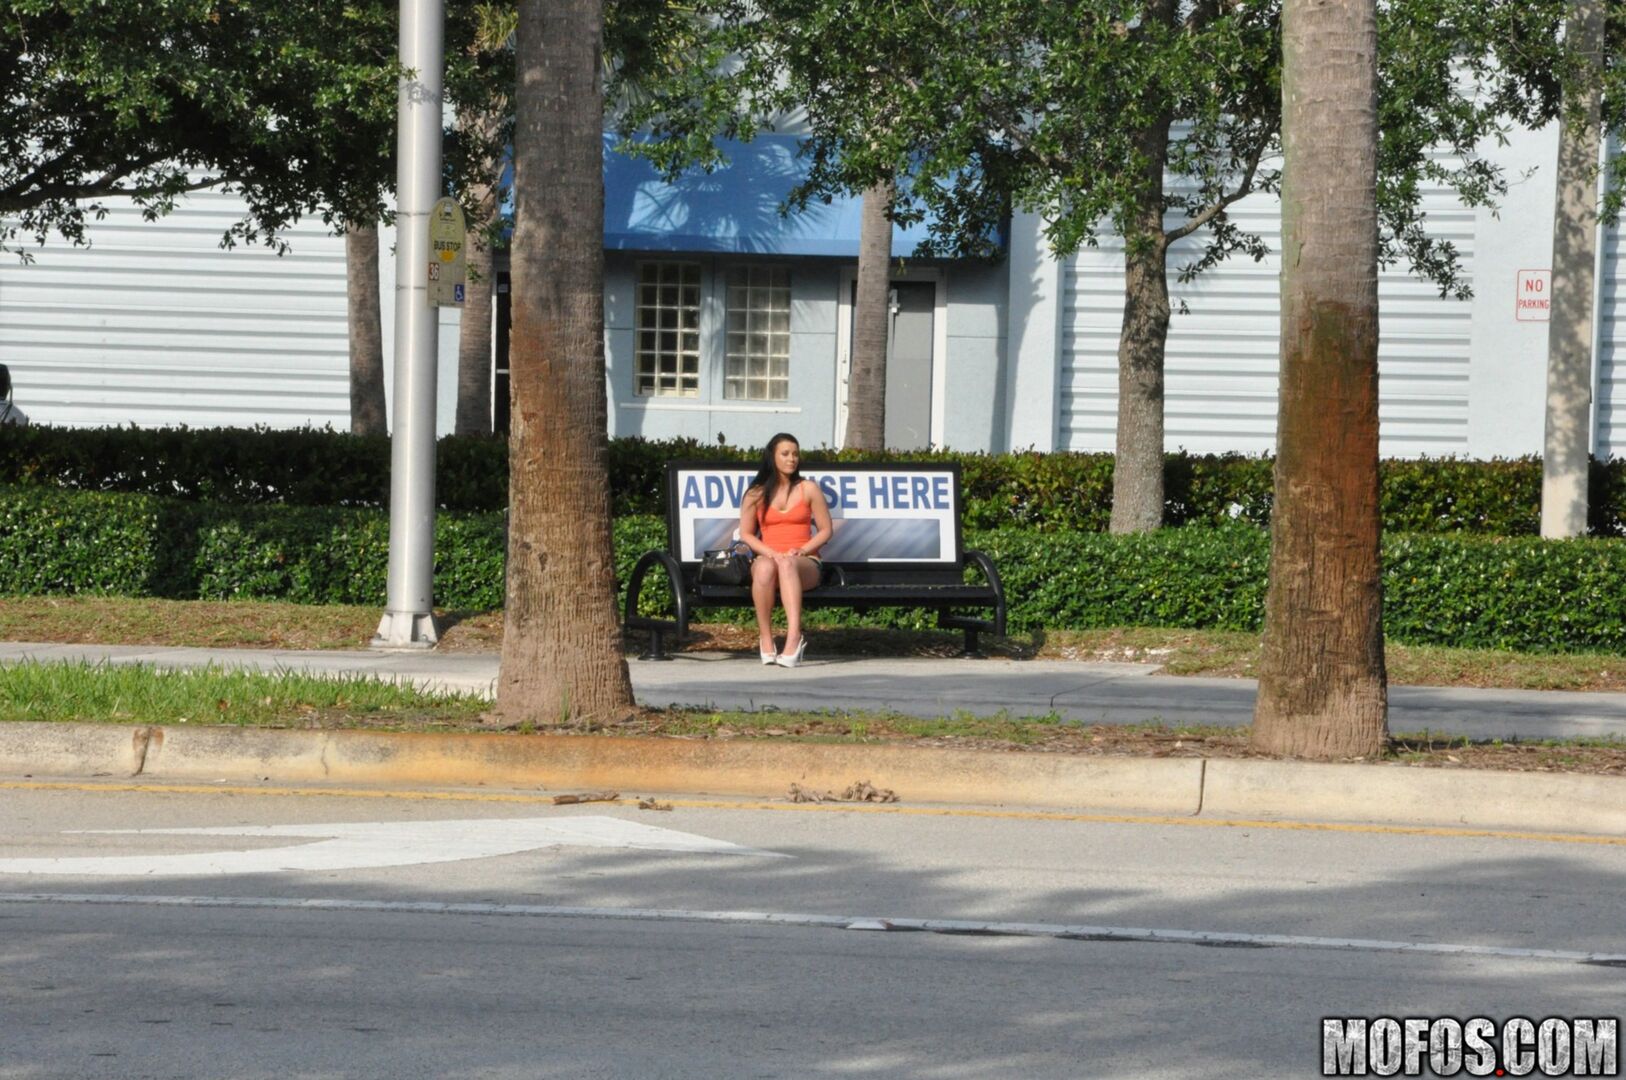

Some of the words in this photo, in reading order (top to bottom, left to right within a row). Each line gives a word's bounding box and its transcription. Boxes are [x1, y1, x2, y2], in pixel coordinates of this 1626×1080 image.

[434, 240, 446, 250] BUS
[446, 241, 461, 251] STOP
[429, 263, 439, 280] 36
[1525, 279, 1543, 292] NO
[1519, 299, 1550, 309] PARKING
[682, 475, 858, 509] ADVSE
[869, 476, 950, 509] HERE
